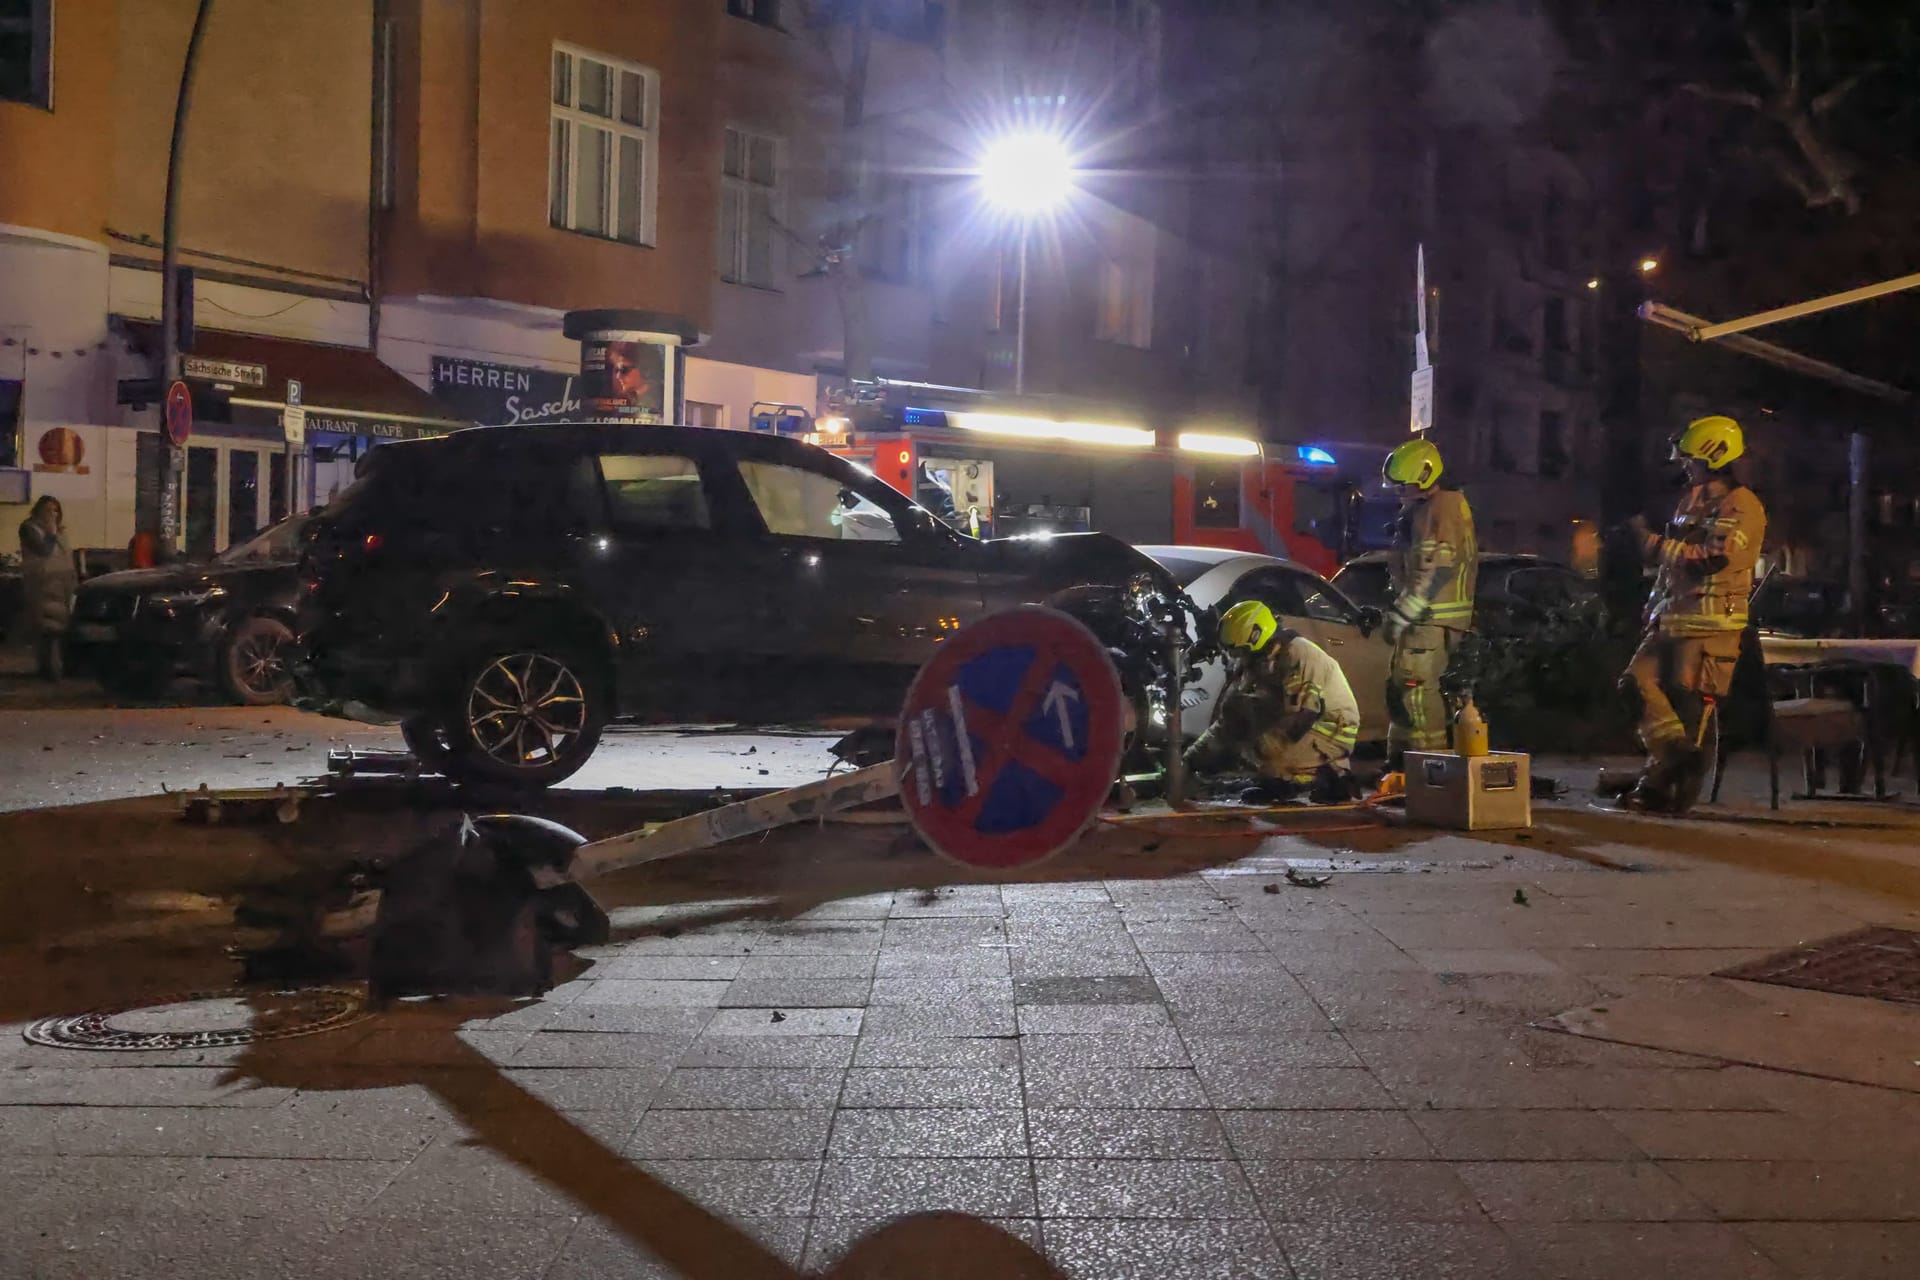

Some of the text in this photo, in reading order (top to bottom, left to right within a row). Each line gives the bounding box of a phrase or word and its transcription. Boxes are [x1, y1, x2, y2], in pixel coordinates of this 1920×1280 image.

[186, 360, 262, 382] Sächsische Straße
[439, 363, 530, 392] HERREN
